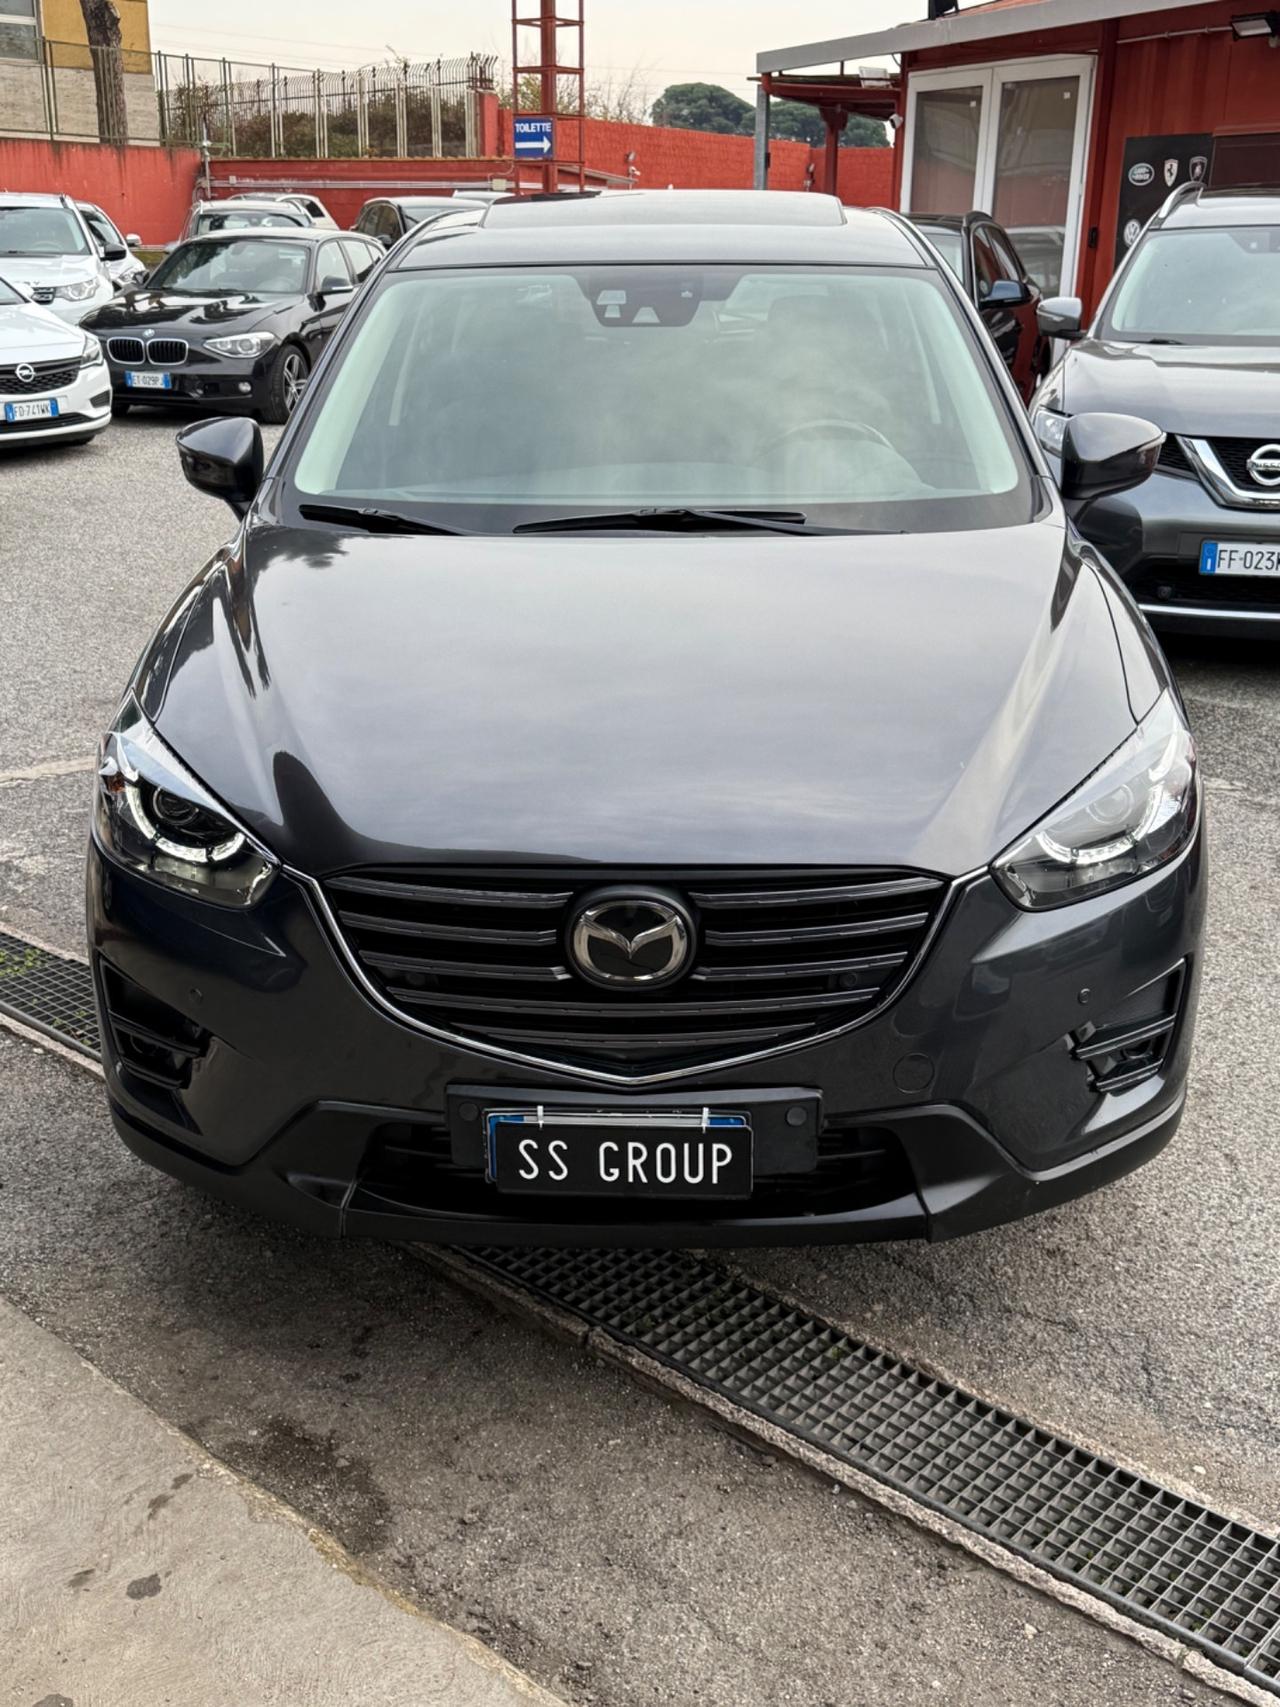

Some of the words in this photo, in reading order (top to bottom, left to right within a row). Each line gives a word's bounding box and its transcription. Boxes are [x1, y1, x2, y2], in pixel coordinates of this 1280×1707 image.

[515, 122, 552, 133] TOILETTE
[518, 1139, 569, 1181] SS
[598, 1141, 733, 1184] GROUP
